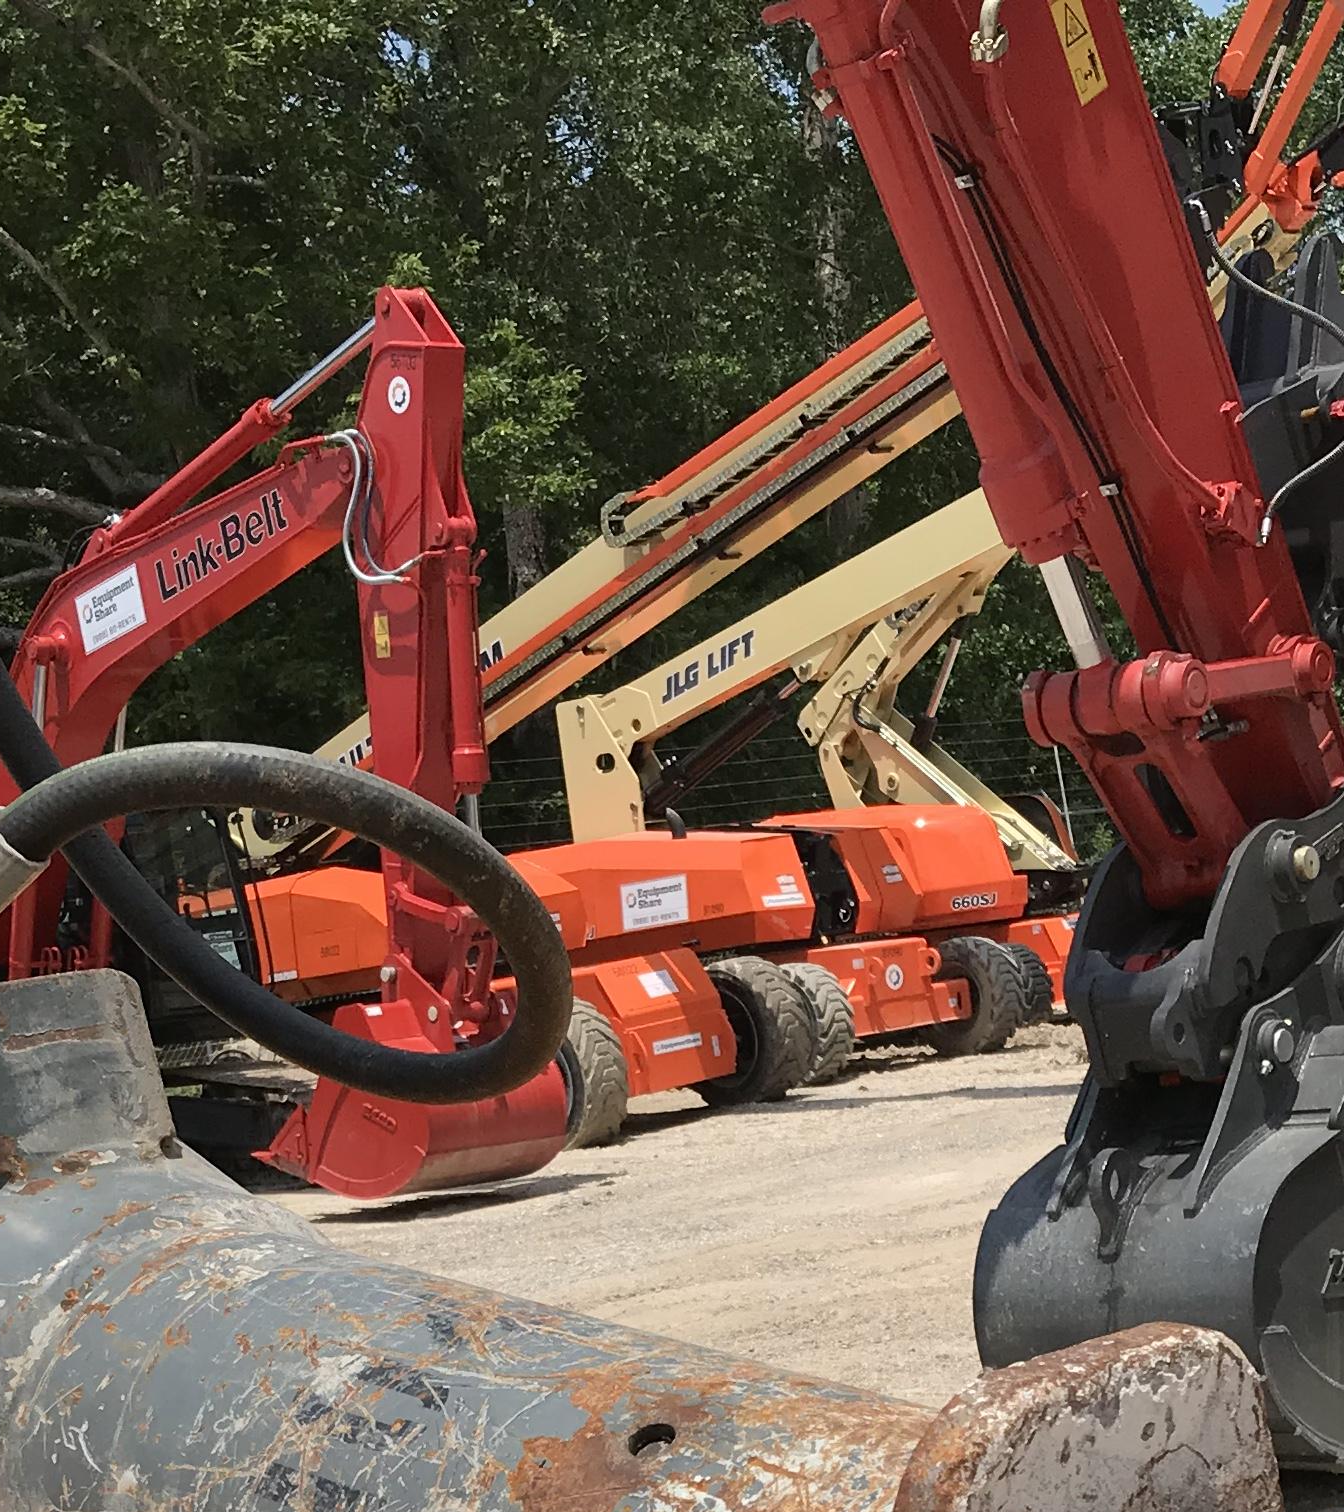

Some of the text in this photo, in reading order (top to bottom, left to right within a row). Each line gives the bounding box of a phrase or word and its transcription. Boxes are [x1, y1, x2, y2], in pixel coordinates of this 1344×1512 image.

[91, 576, 135, 609] Equipment
[94, 602, 118, 622] Share
[661, 629, 754, 705] JLG LIFT
[637, 881, 682, 900] Equipment
[638, 897, 662, 910] Share
[951, 892, 997, 910] 660SJ
